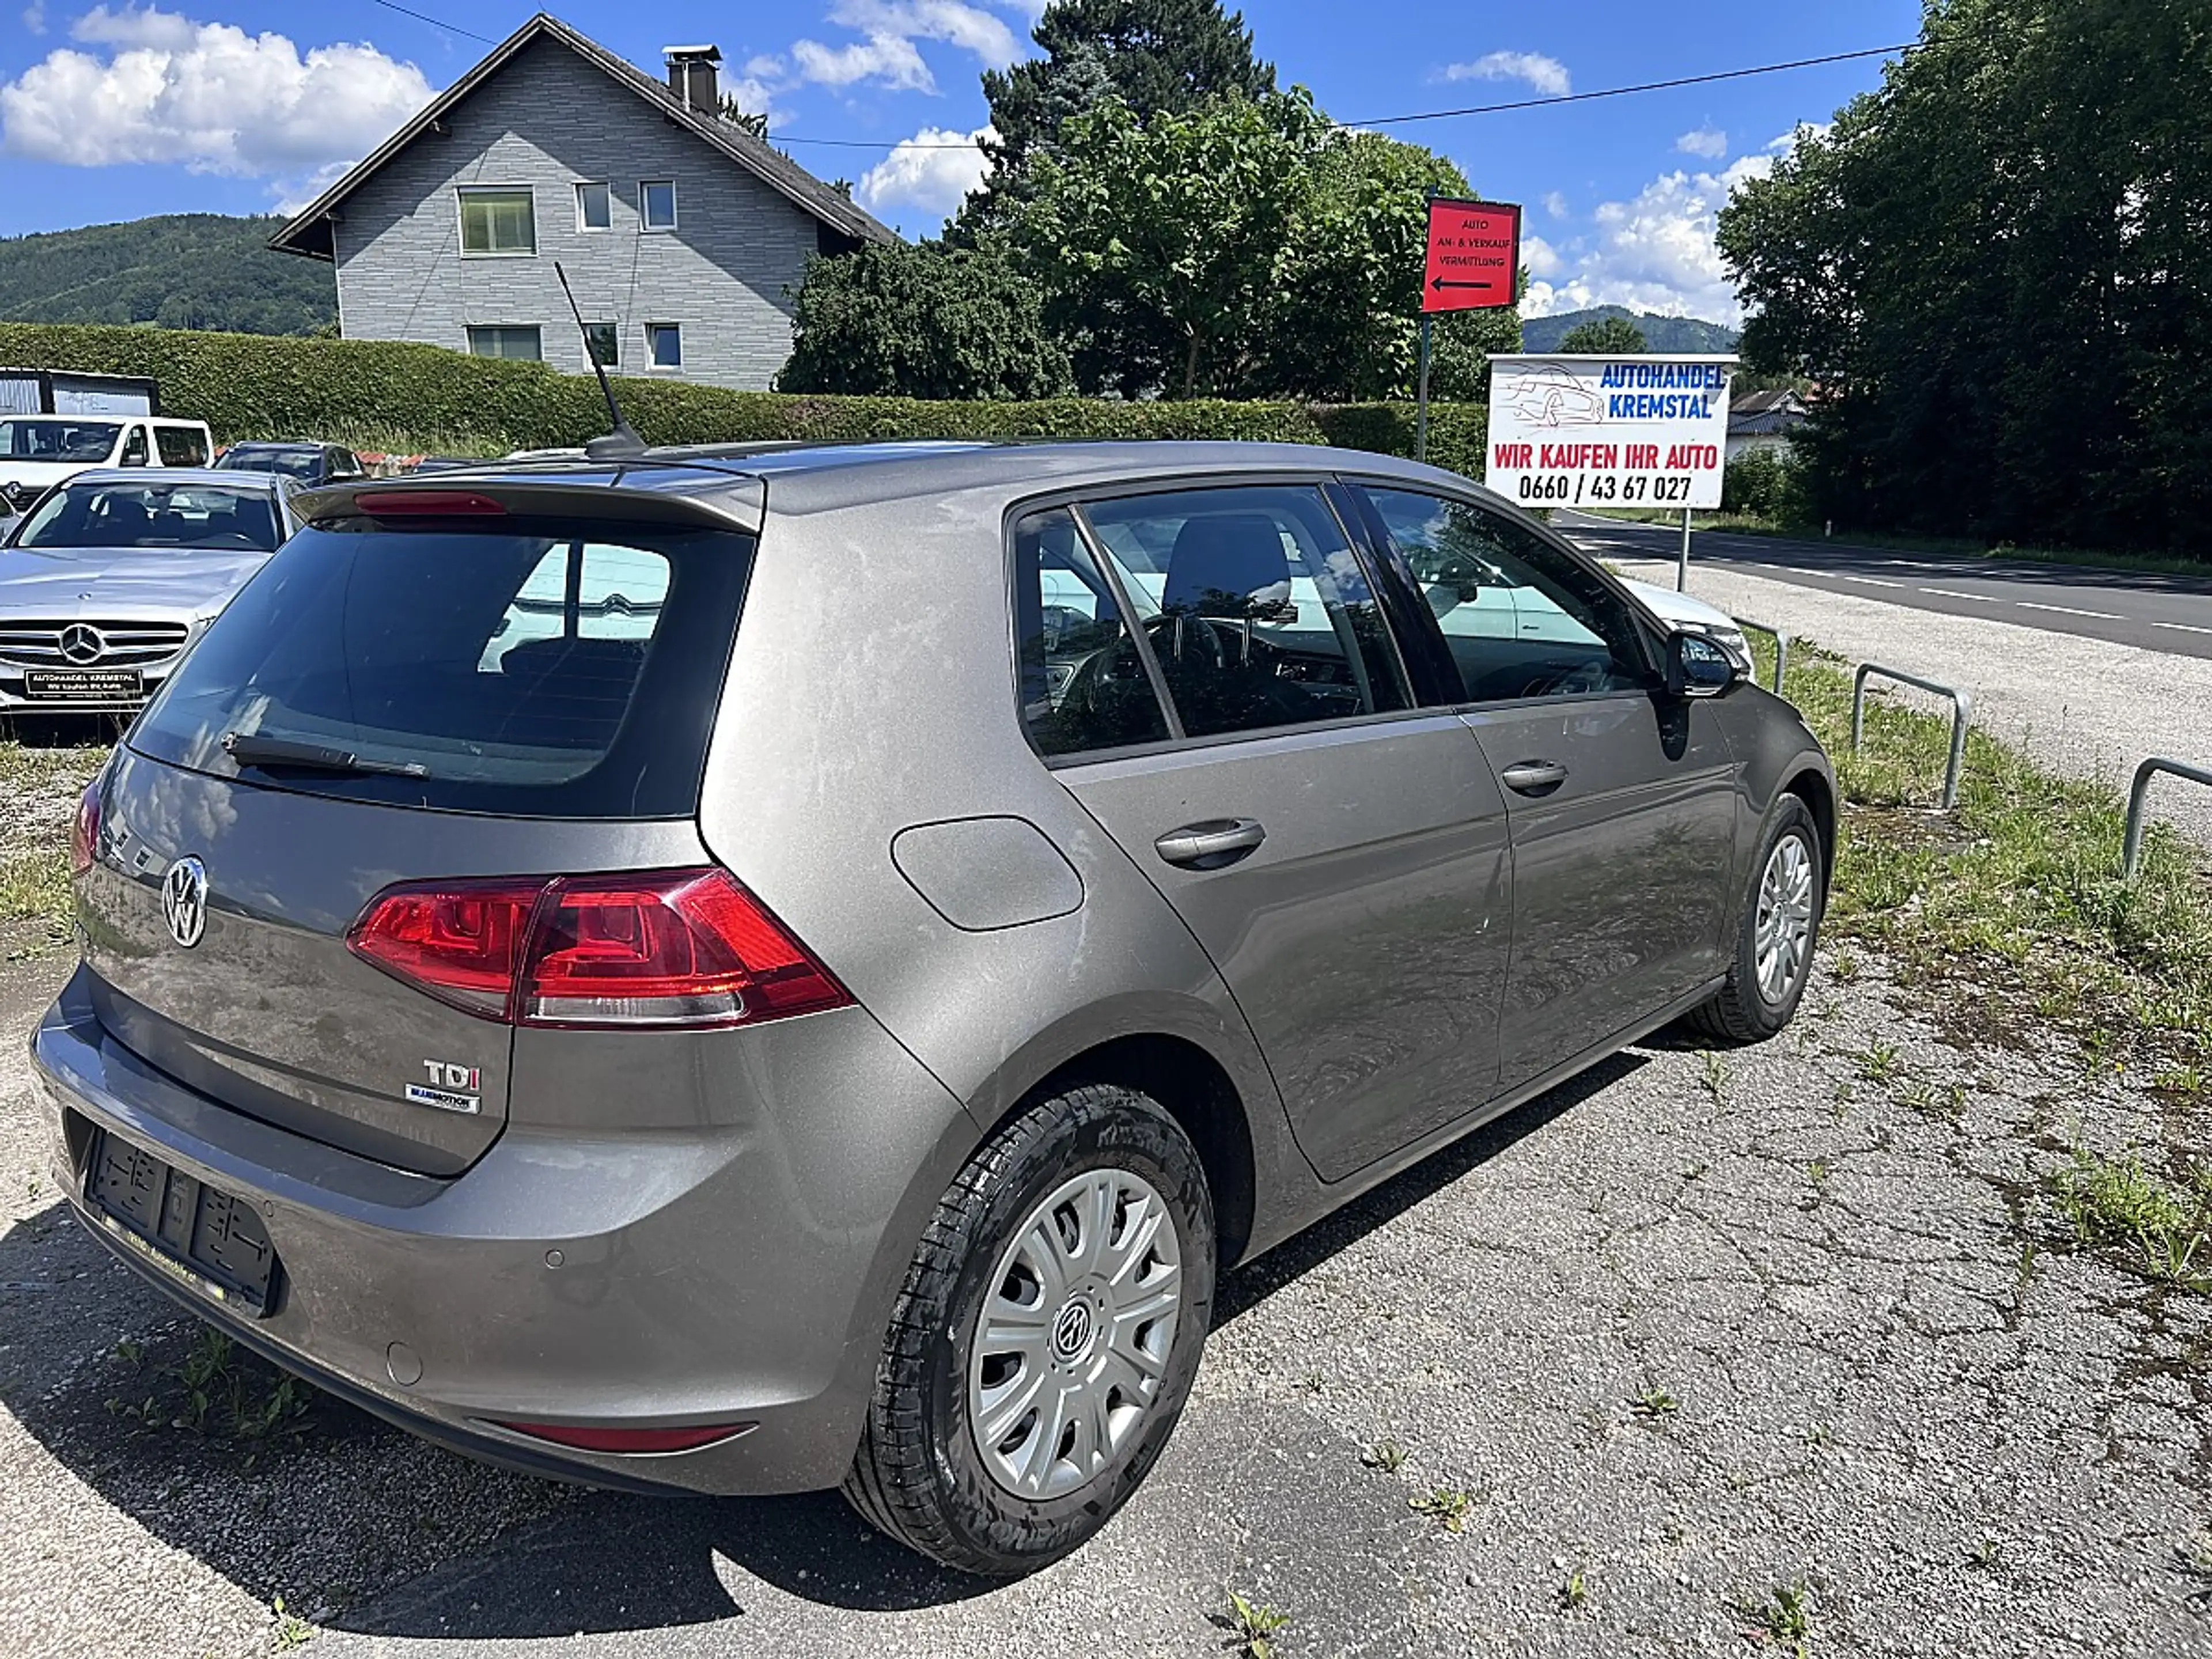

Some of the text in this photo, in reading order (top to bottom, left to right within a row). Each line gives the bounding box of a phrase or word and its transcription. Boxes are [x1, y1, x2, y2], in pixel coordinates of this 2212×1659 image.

[1461, 219, 1488, 229] AUTO
[1458, 238, 1465, 247] &
[1468, 238, 1510, 248] VERKAUF
[1439, 256, 1505, 266] VERMITTLUNG
[1600, 364, 1727, 389] AUTOHANDEL
[1609, 394, 1712, 419] KREMSTAL
[1494, 444, 1717, 470] WIR KAUFEN IHR AUTO
[1519, 474, 1691, 503] 0660 / 43 67 027
[423, 1059, 480, 1091] TDI
